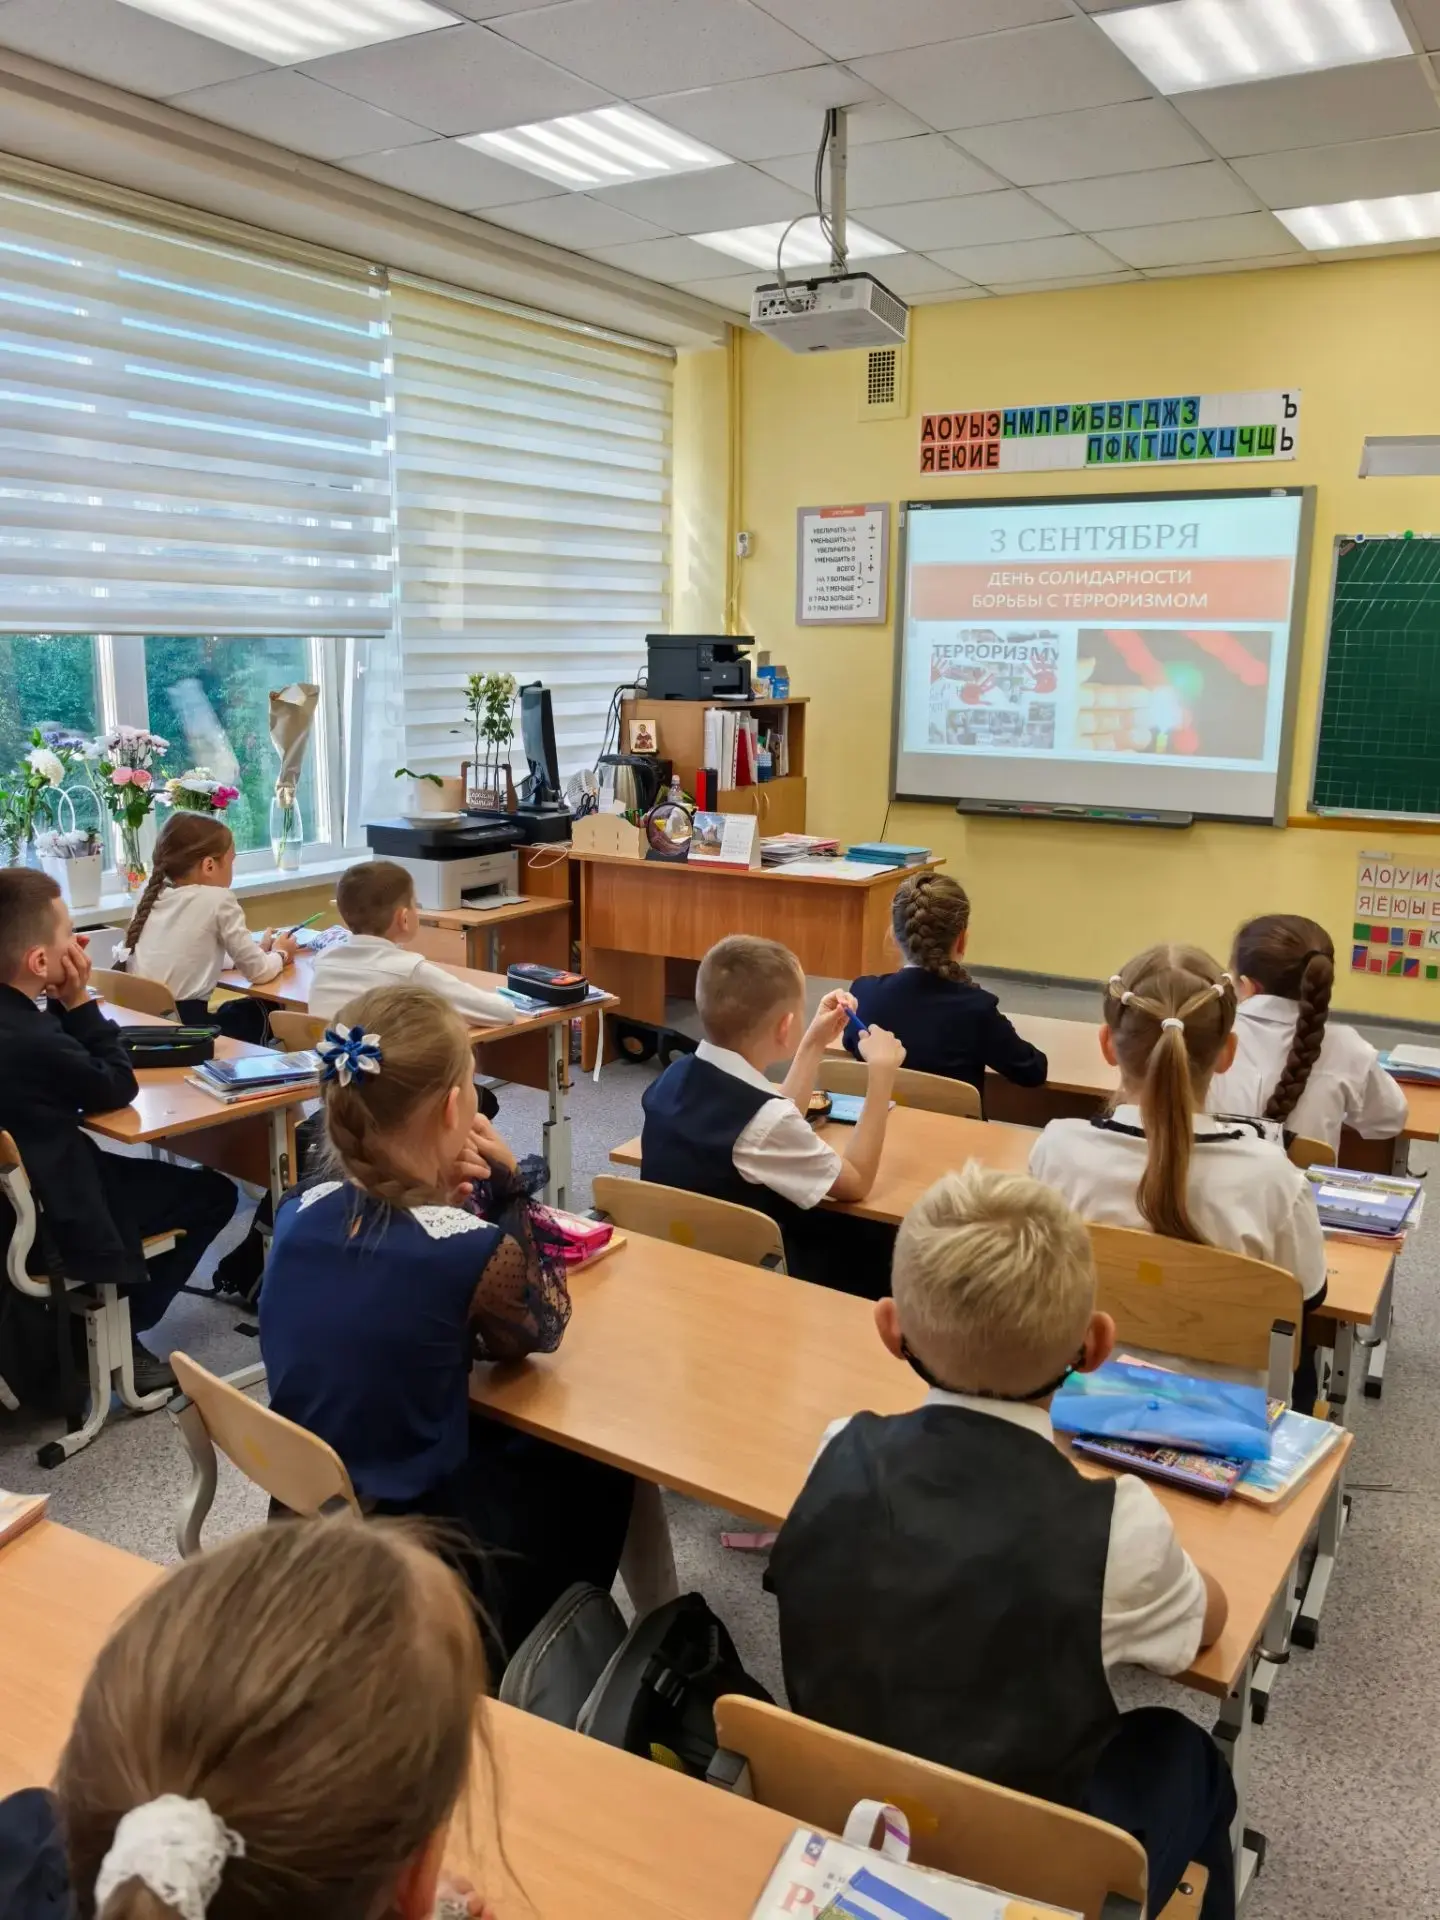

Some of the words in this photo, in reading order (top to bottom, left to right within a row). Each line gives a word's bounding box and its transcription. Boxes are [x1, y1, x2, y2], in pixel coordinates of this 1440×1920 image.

[989, 528, 1007, 554] 3
[1018, 522, 1201, 553] СЕНТЯБРЯ
[987, 571, 1034, 588] ДЕНЬ
[1038, 569, 1192, 586] СОЛИДАРНОСТИ
[972, 593, 1042, 609] БОРЬБЫ
[1046, 593, 1060, 608] С
[1063, 592, 1208, 608] ТЕРРОРИЗМОМ
